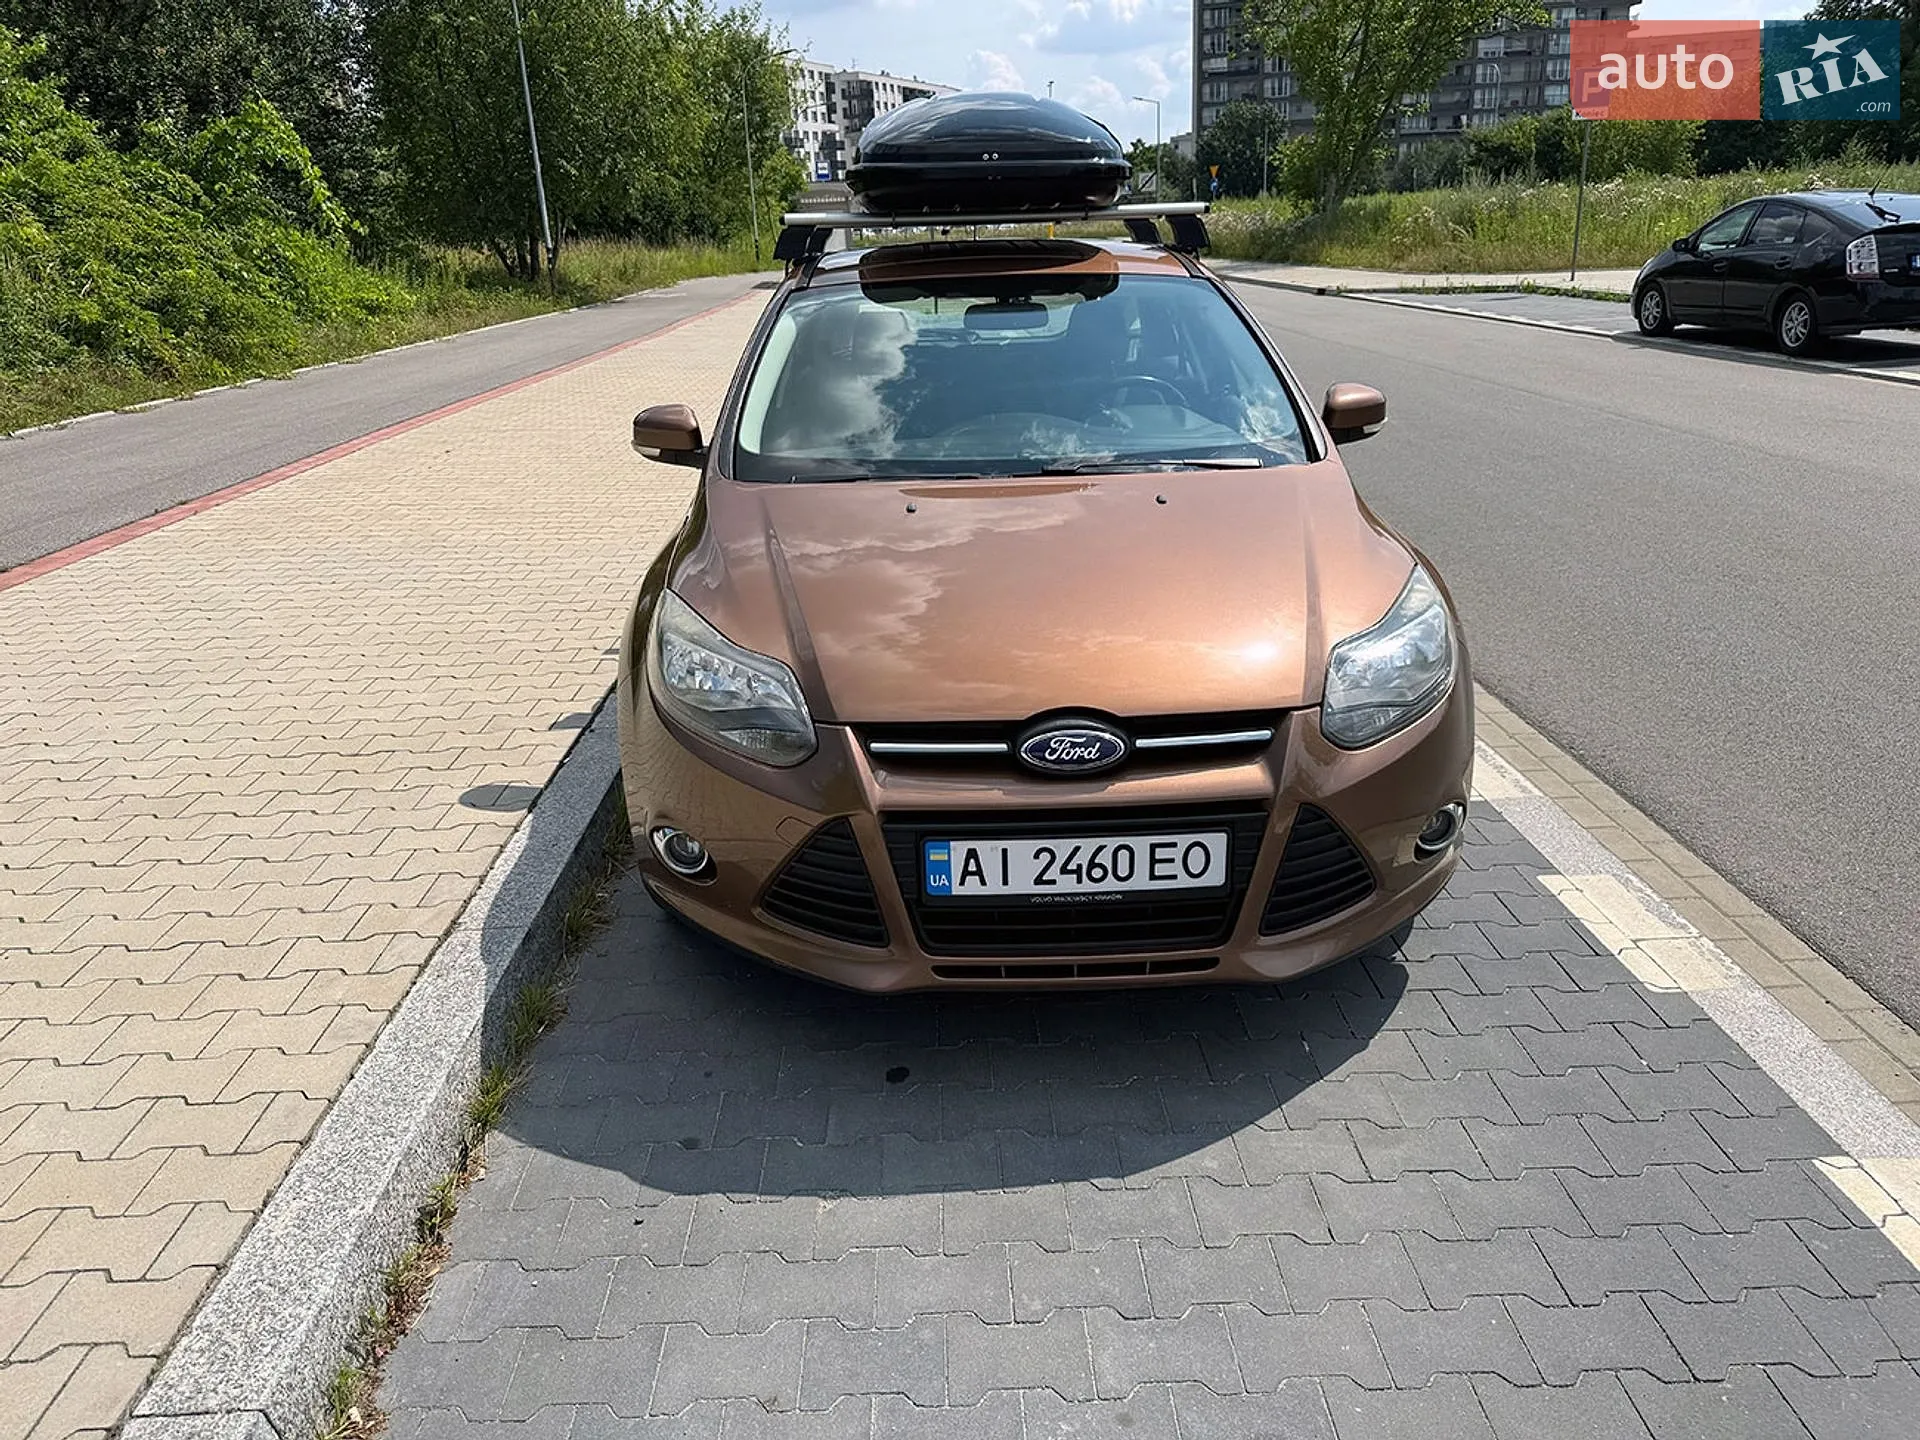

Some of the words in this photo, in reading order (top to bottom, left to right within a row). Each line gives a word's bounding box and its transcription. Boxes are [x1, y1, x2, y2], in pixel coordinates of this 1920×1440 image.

[1045, 736, 1100, 760] Ford
[959, 847, 1009, 887] AI
[1033, 843, 1135, 886] 2460
[1149, 840, 1211, 881] EO
[930, 874, 949, 887] UA
